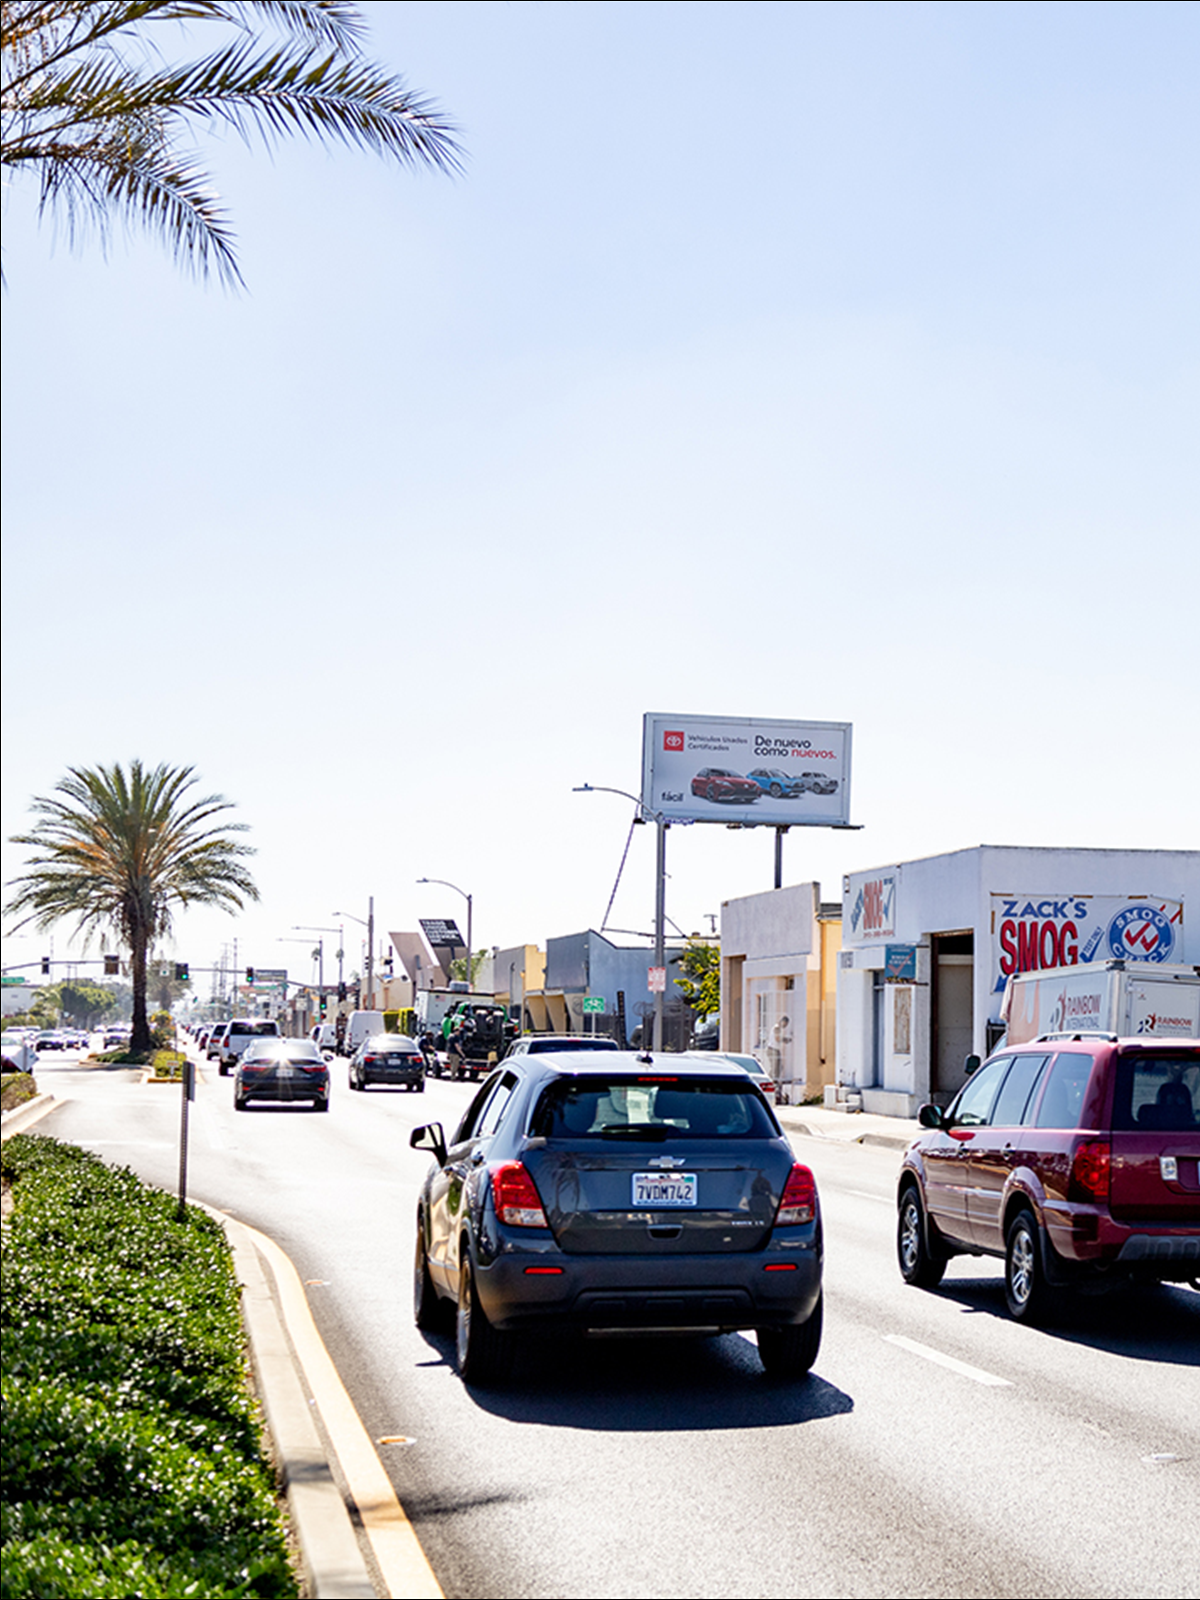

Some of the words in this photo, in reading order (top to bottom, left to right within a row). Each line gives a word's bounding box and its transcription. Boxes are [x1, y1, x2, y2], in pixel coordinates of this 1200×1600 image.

[755, 735, 771, 747] De
[774, 738, 811, 748] nuevo
[754, 747, 789, 757] como
[791, 749, 837, 760] nuevos.
[1002, 897, 1087, 919] ZACK'S
[1115, 909, 1165, 929] SMOG
[1000, 919, 1079, 976] SMOG
[1112, 942, 1170, 962] CCK
[1067, 994, 1101, 1016] RAINBOW
[1157, 1016, 1192, 1026] RAINBOW
[637, 1185, 692, 1200] 7VDM742
